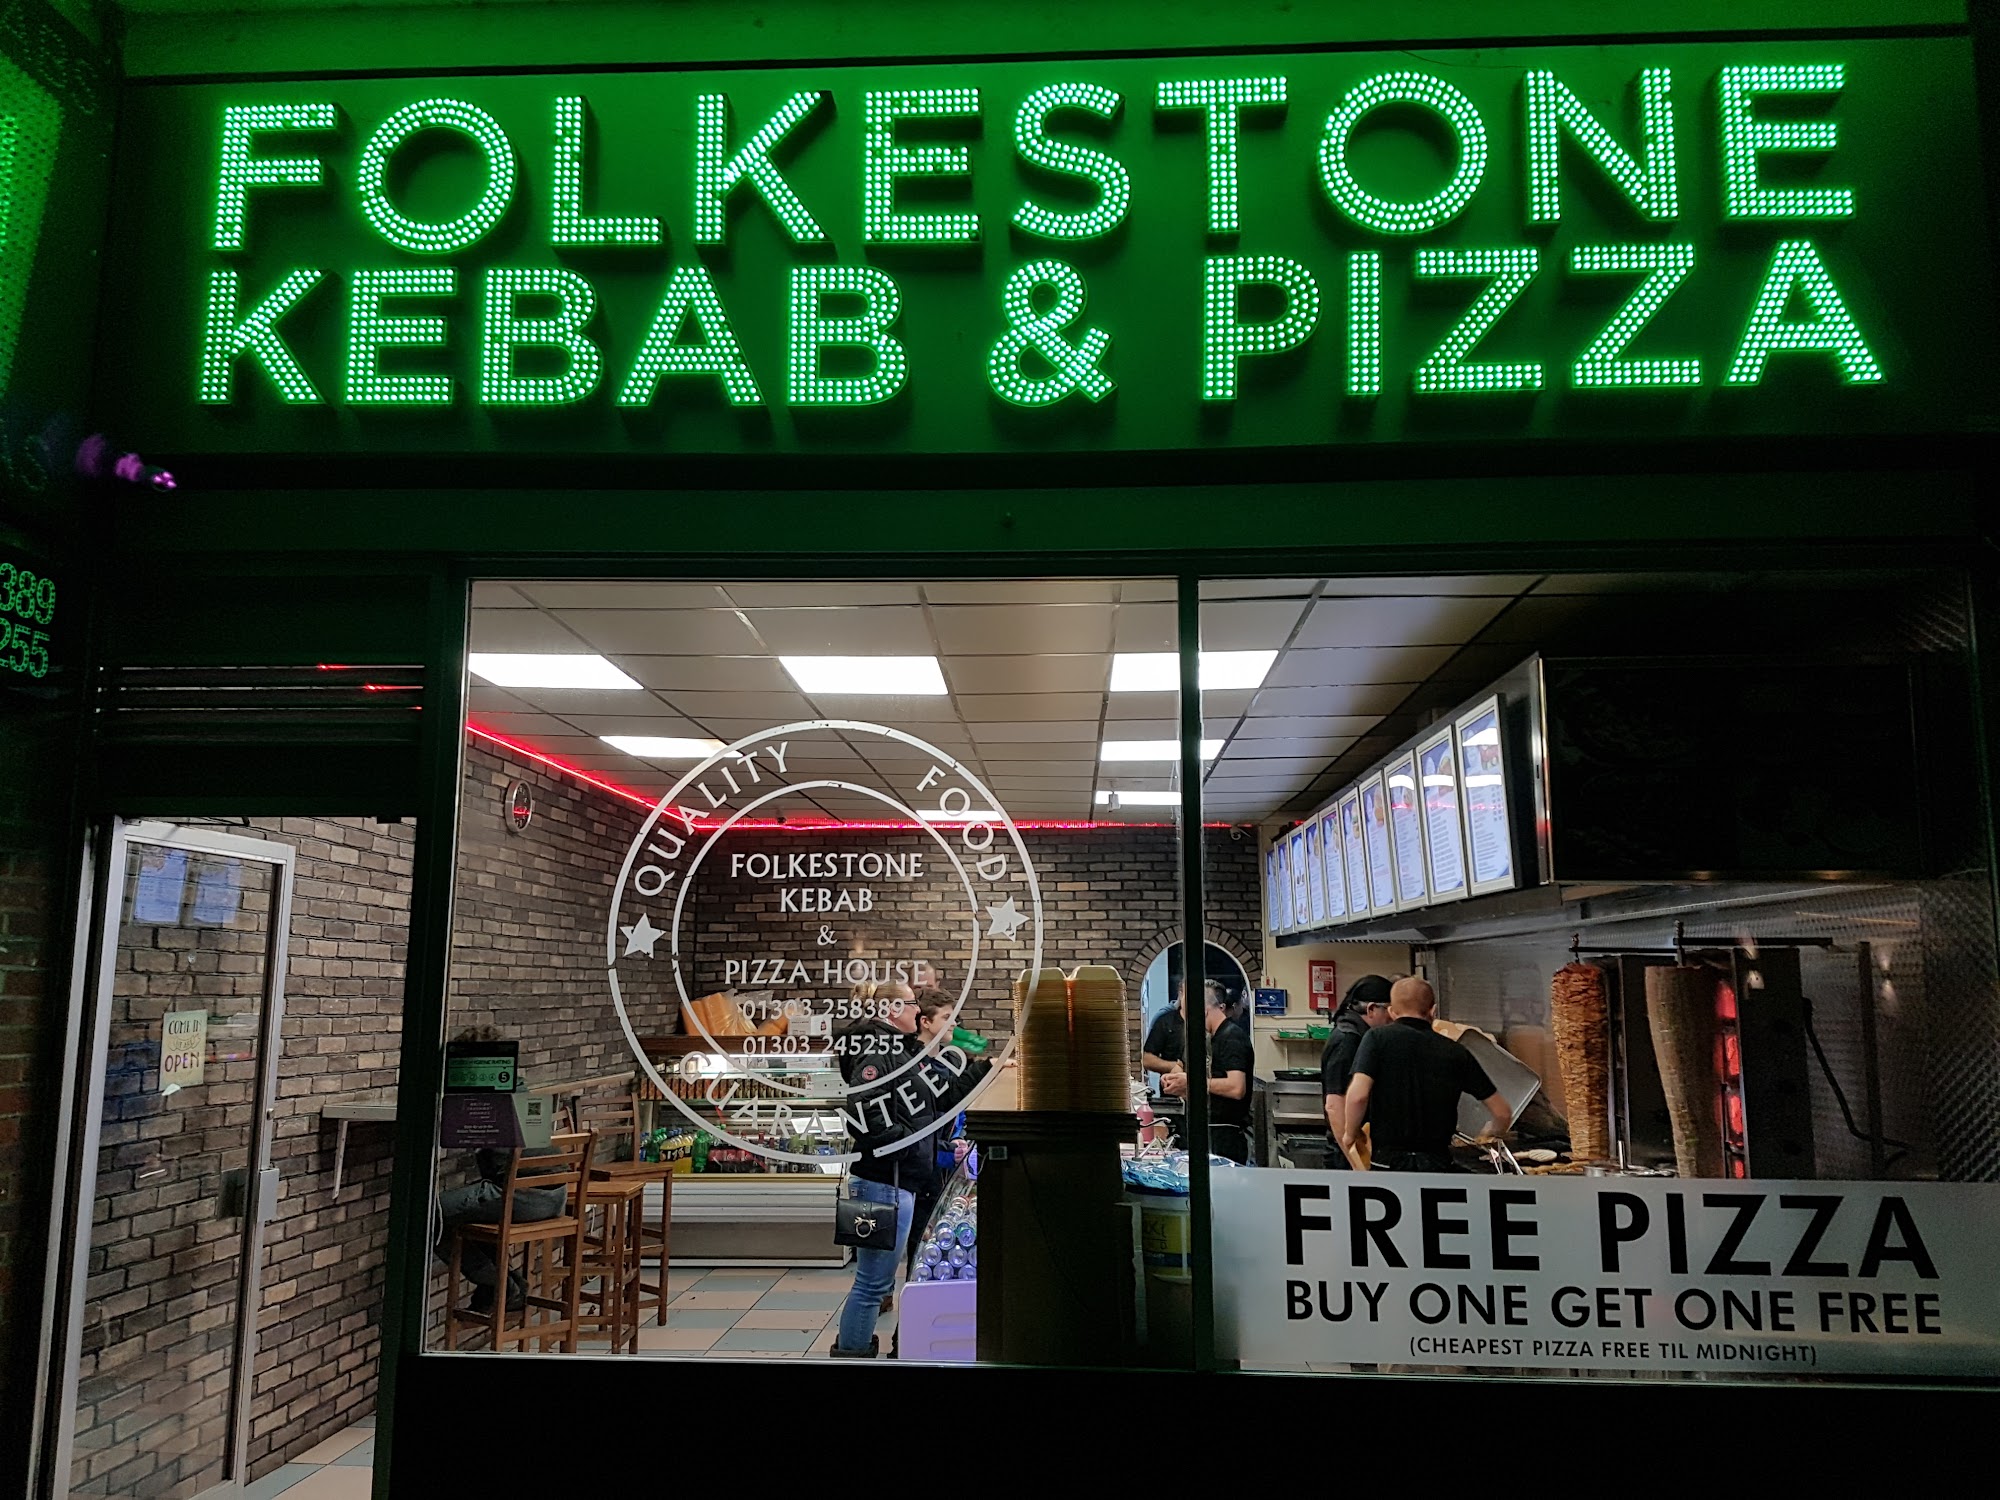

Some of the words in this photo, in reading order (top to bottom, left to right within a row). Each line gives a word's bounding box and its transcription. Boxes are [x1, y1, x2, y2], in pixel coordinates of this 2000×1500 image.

[212, 64, 1855, 252] FOLKESTONE
[200, 265, 910, 407] KEBAB
[986, 258, 1117, 406] &
[1203, 240, 1886, 401] PIZZA
[634, 742, 788, 897] QUALITY
[917, 765, 1007, 881] FOOD
[731, 853, 925, 879] FOLKESTONE
[780, 888, 873, 912] KEBAB
[817, 925, 838, 945] &
[725, 959, 811, 985] PIZZA
[823, 959, 929, 986] HOUSE
[742, 999, 812, 1020] 01303
[822, 998, 905, 1020] 258389
[743, 1035, 810, 1055] 01303
[822, 1034, 905, 1056] 245255
[164, 1051, 200, 1073] OPEN
[501, 1072, 508, 1082] 5
[680, 1045, 968, 1142] GUARANTEED
[1283, 1184, 1541, 1271] FREE
[1597, 1191, 1939, 1280] PIZZA
[1286, 1280, 1389, 1321] BUY
[1408, 1282, 1529, 1326] ONE
[1551, 1285, 1653, 1329] GET
[1673, 1287, 1796, 1332] ONE
[1819, 1292, 1941, 1335] FREE
[1409, 1336, 1523, 1356] (CHEAPEST
[1533, 1340, 1594, 1357] PIZZA
[1602, 1342, 1650, 1358] FREE
[1658, 1342, 1689, 1359] TIL
[1697, 1343, 1817, 1366] MIDNIGHT)
